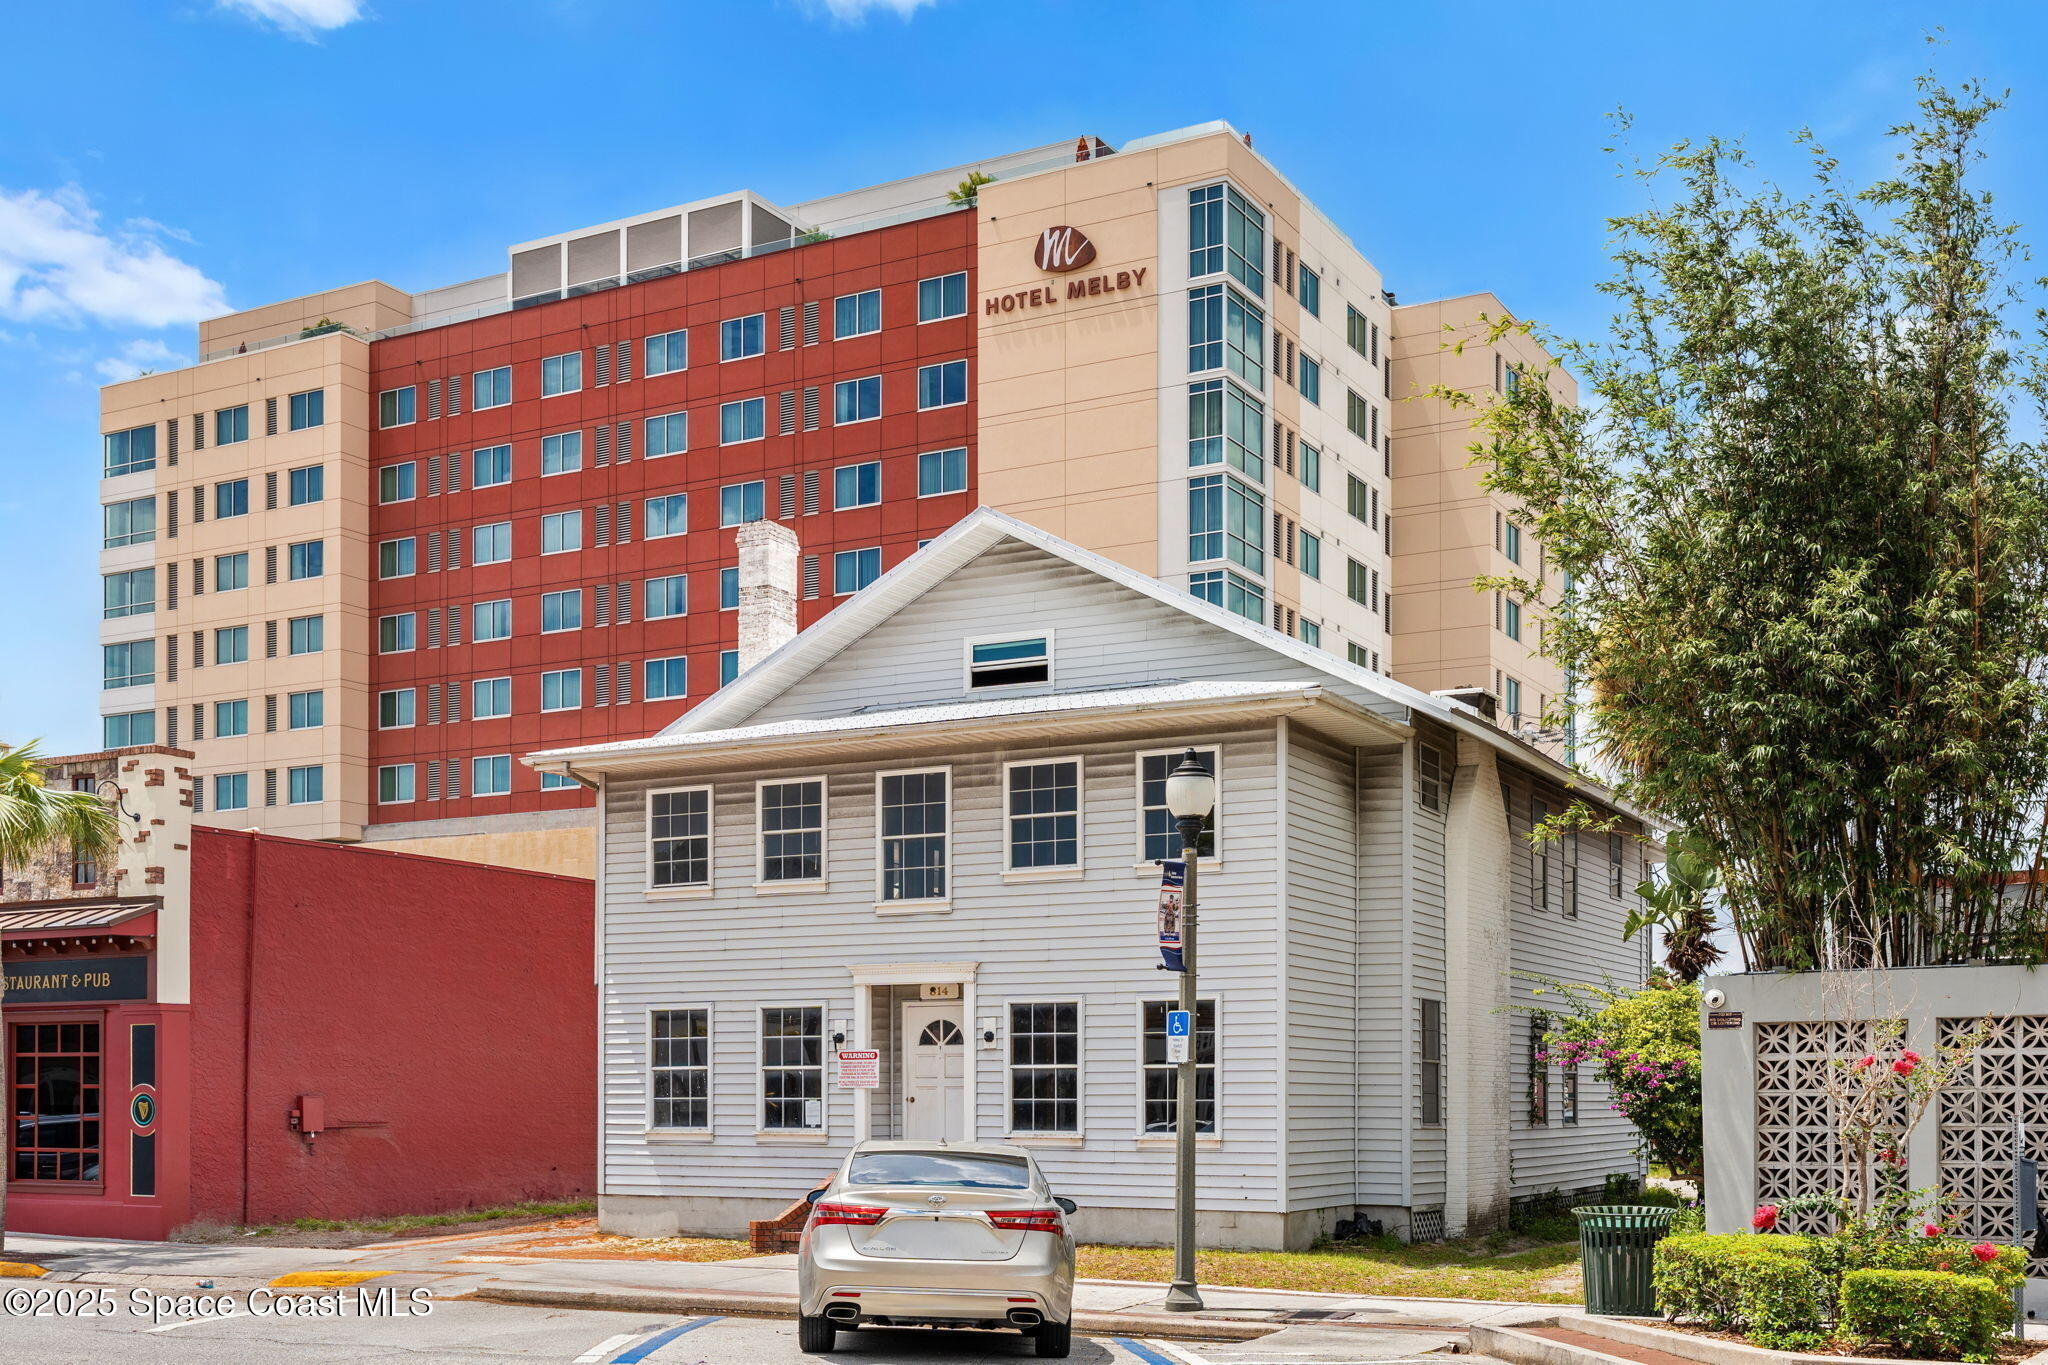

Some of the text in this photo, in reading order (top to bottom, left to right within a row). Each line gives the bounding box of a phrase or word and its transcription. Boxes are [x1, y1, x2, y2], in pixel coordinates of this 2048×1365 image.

[985, 267, 1147, 315] HOTEL MELBY
[71, 974, 82, 988] &
[84, 972, 111, 988] PUB
[929, 986, 949, 996] 814
